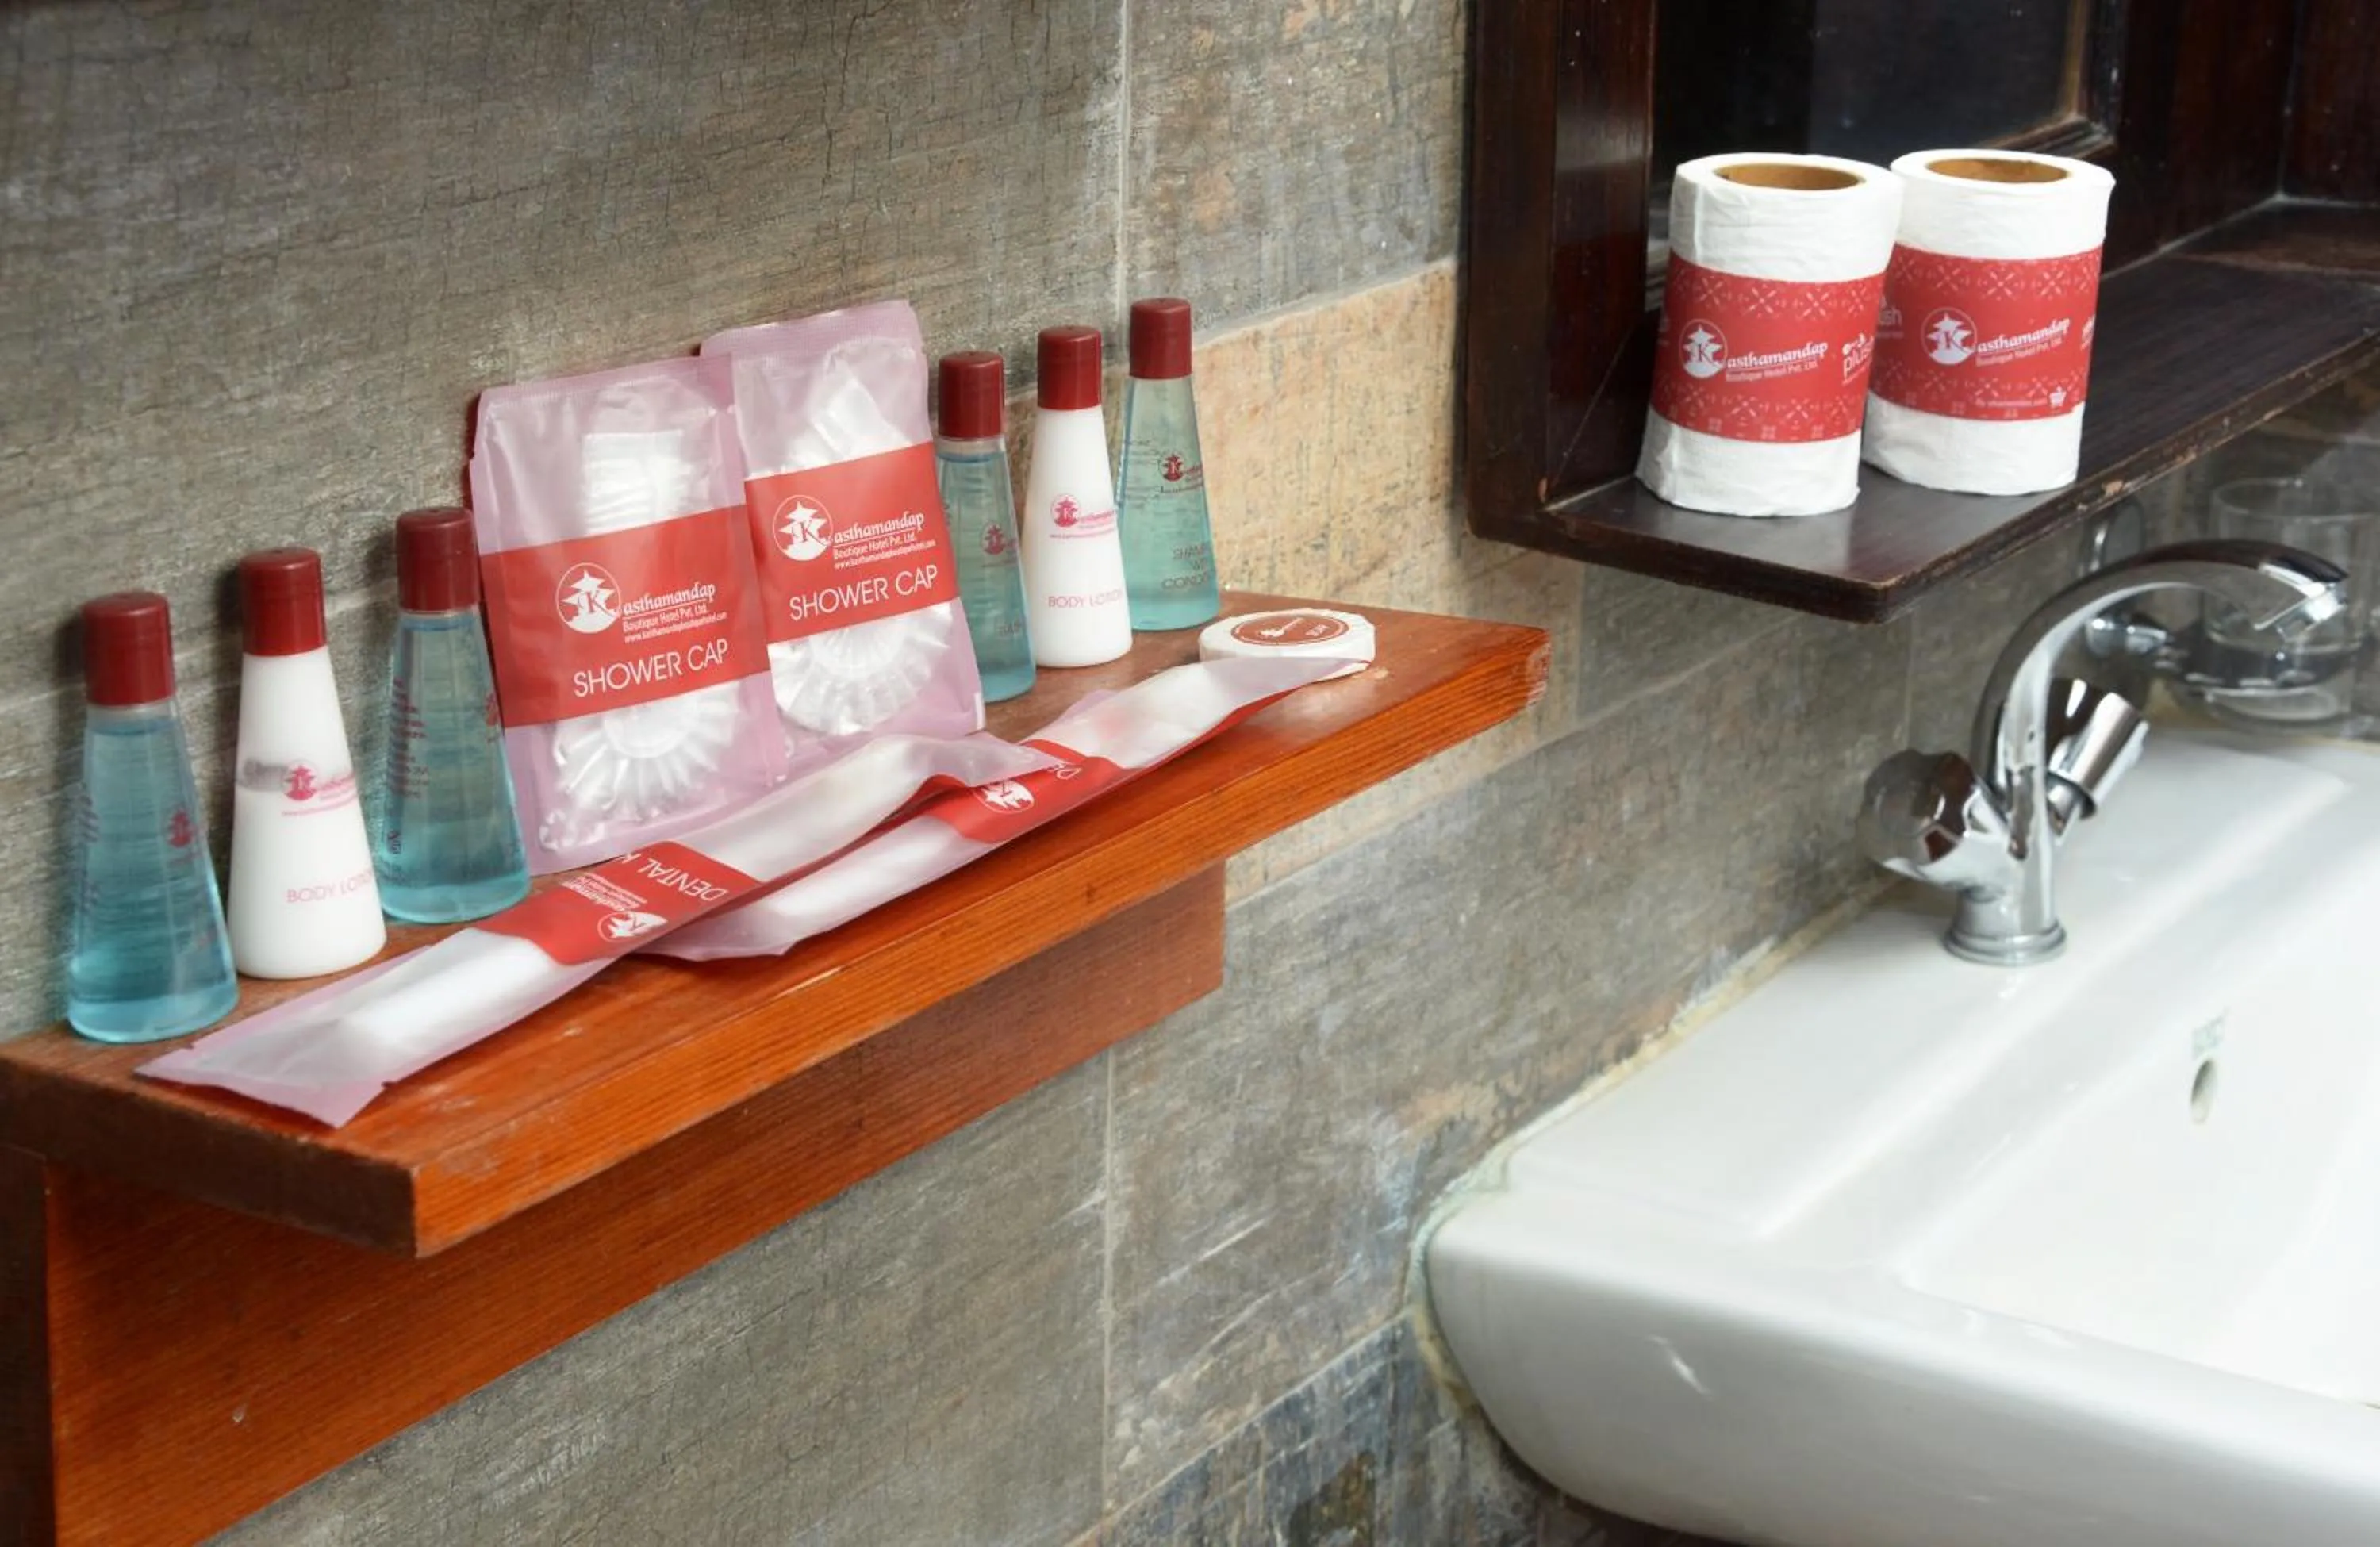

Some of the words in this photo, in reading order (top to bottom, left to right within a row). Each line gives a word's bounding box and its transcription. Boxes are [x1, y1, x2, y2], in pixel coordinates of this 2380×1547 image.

[789, 577, 889, 622] SHOWER
[895, 564, 938, 596] CAP
[1047, 595, 1084, 608] BODY
[574, 651, 682, 697] SHOWER
[687, 638, 728, 671] CAP
[286, 884, 336, 904] BODY
[637, 858, 730, 902] DENTAL
